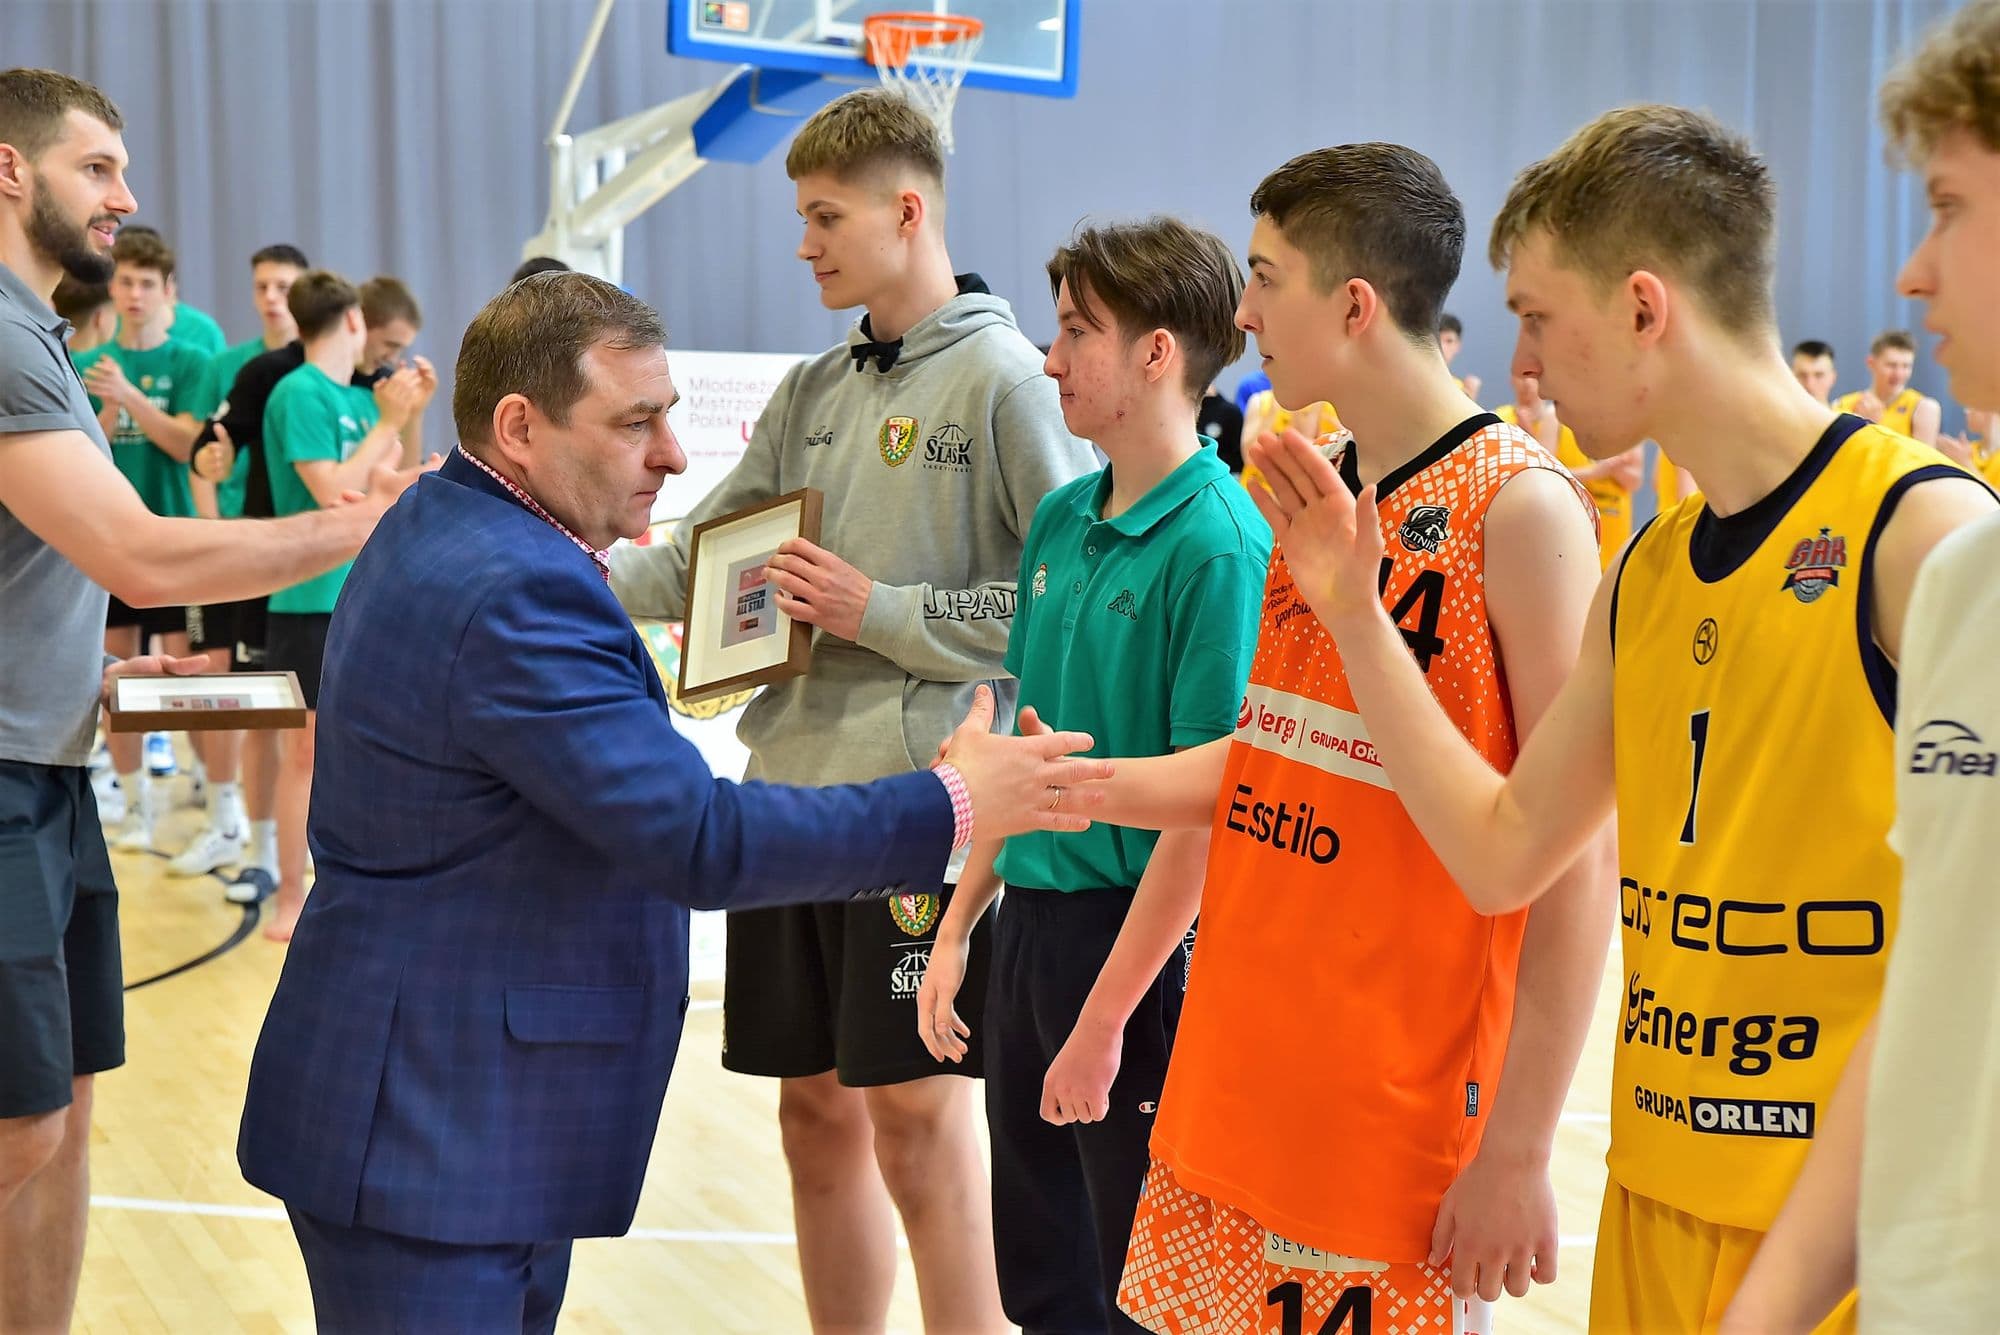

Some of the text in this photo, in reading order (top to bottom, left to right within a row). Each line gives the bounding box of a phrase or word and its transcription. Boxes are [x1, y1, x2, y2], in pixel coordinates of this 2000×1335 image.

[1400, 525, 1437, 552] HUTNIK
[1310, 730, 1348, 754] GRUPA
[1909, 742, 1998, 776] Enea
[1679, 711, 1710, 845] 1
[1226, 783, 1341, 865] Esstilo
[1639, 987, 1820, 1076] Energa
[1634, 1084, 1808, 1134] GRUPA ORLEN
